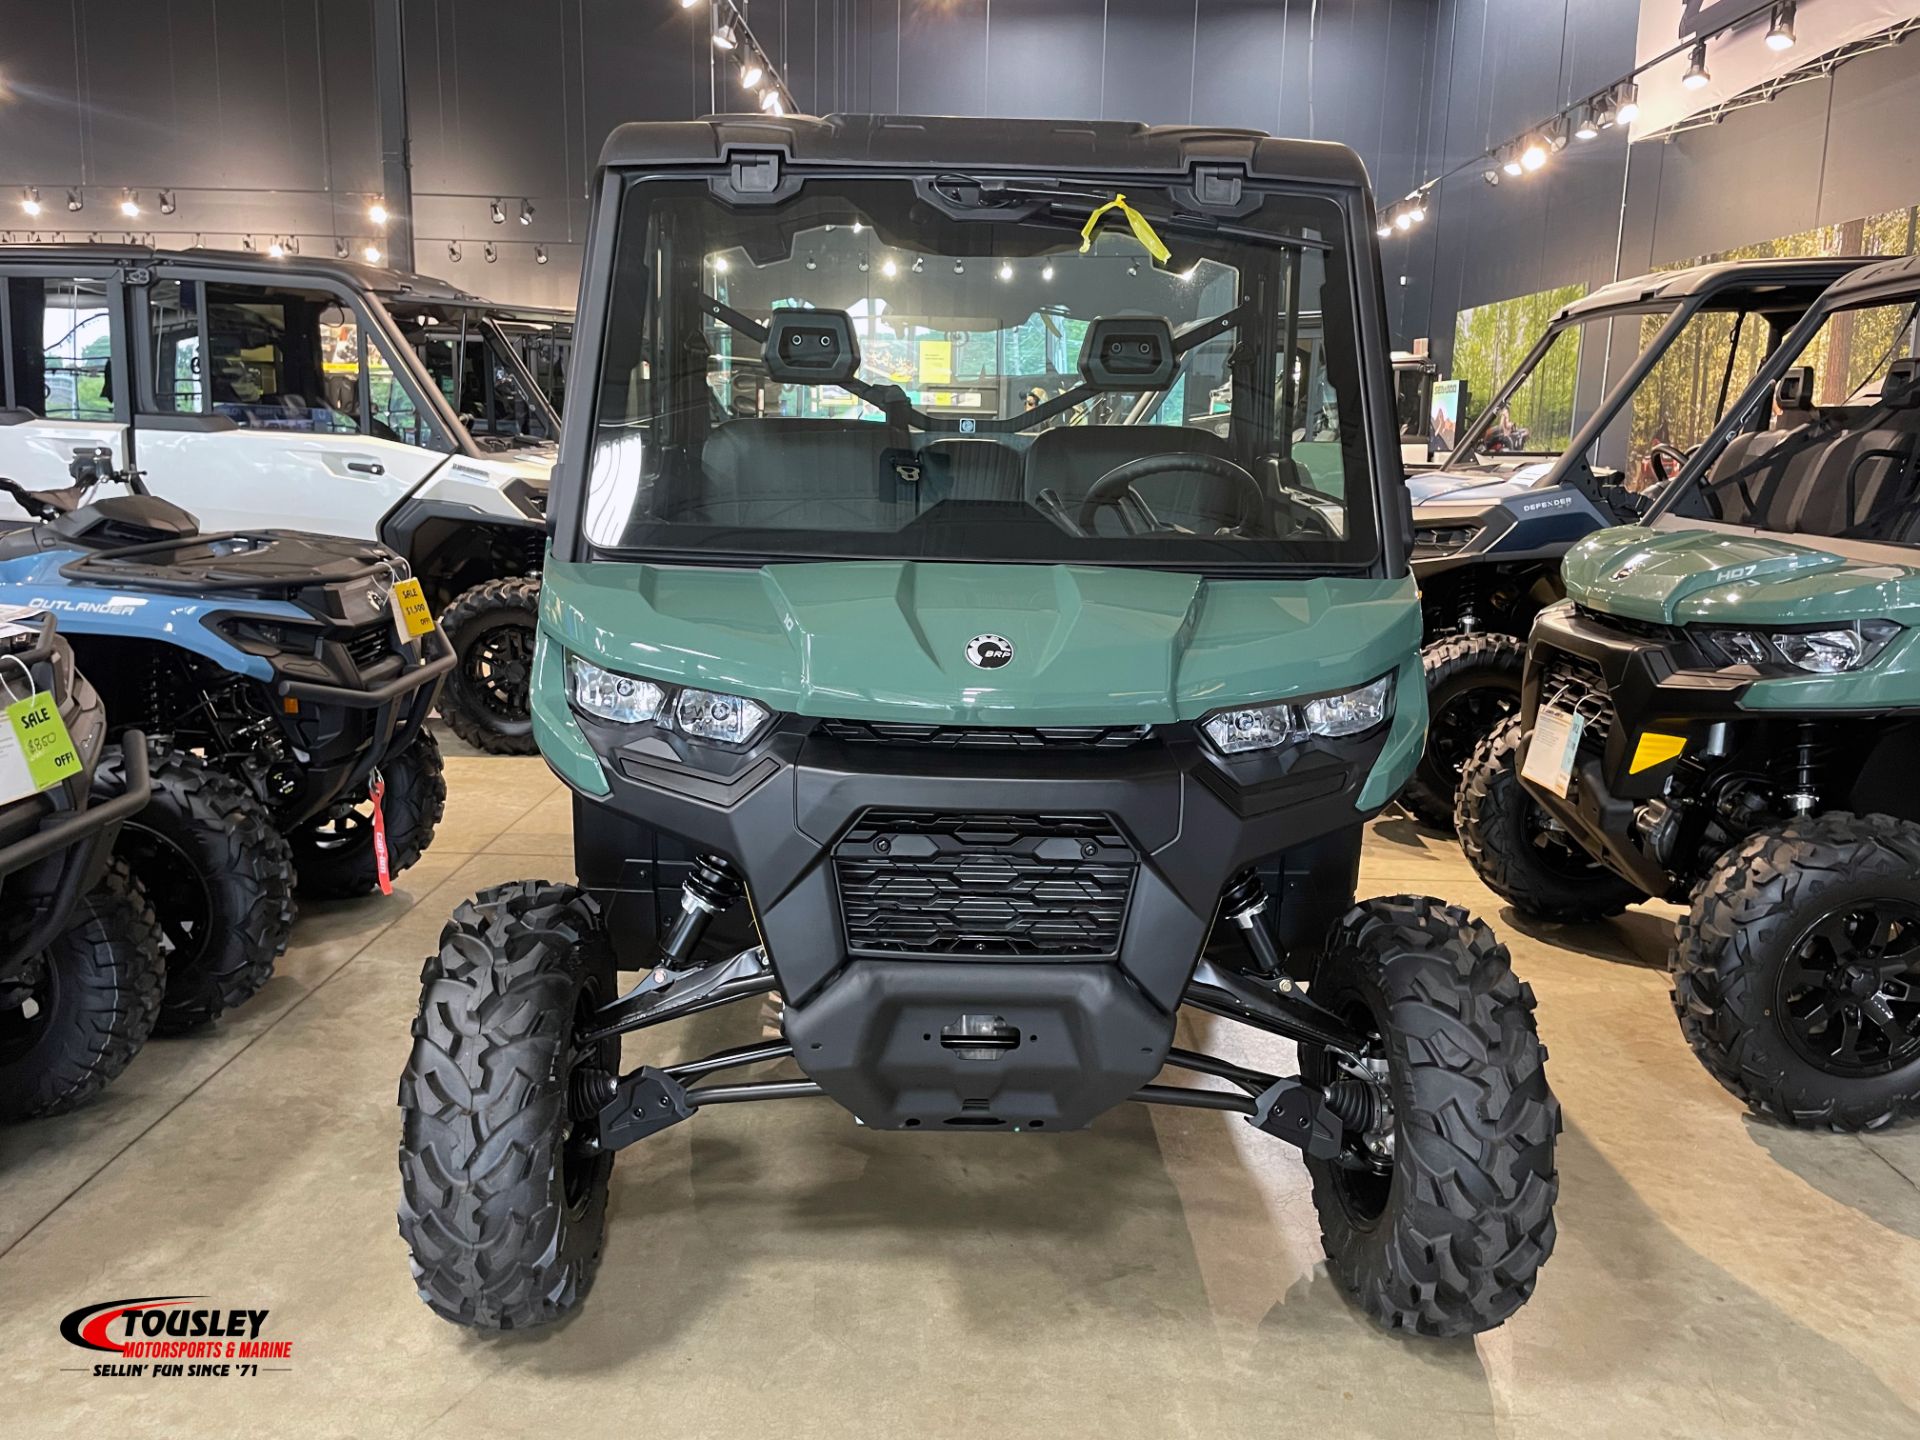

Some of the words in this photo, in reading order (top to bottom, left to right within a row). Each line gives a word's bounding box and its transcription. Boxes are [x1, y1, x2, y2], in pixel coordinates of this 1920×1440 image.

[1523, 497, 1572, 511] DEFENDER
[1717, 565, 1757, 582] HD7
[402, 588, 418, 599] SALE
[28, 598, 136, 616] OUTLANDER
[984, 650, 1011, 658] BRP
[21, 708, 51, 729] SALE
[54, 752, 75, 767] OFF!
